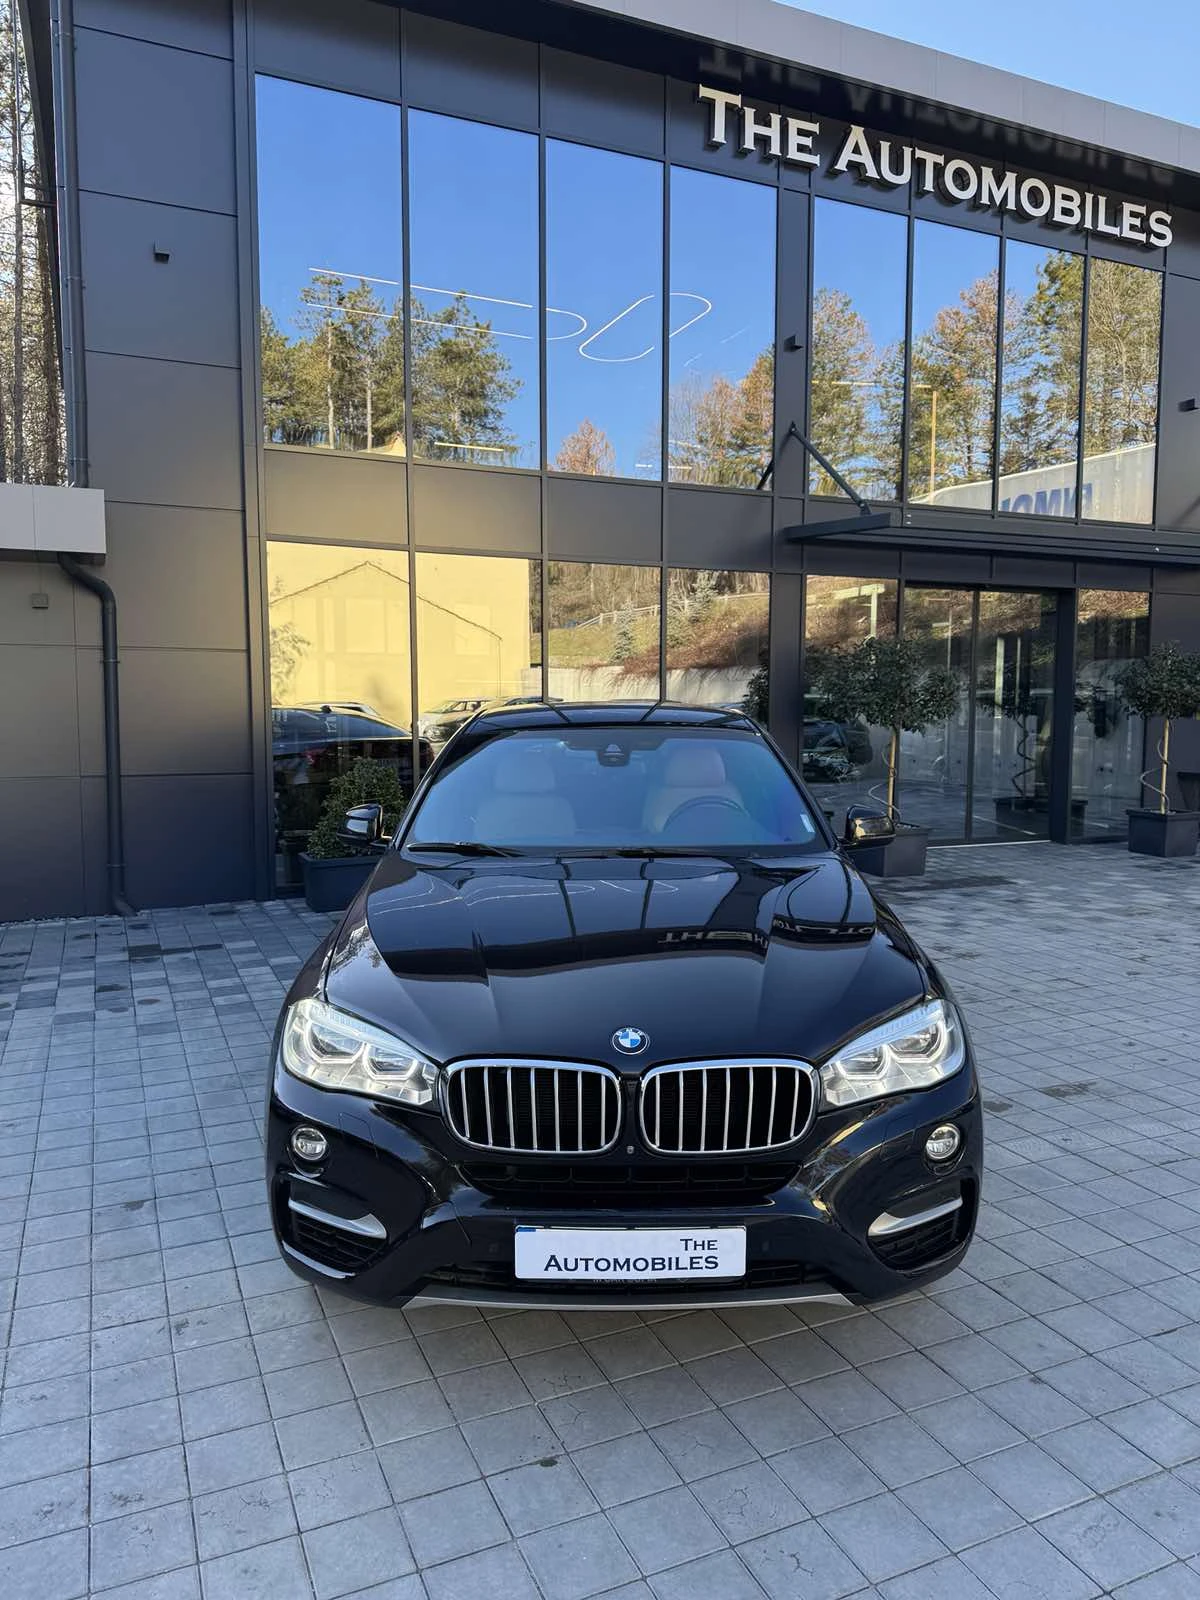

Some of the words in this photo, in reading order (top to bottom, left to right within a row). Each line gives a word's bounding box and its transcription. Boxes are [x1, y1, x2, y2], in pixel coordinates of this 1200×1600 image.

[699, 83, 820, 167] THE
[833, 125, 1173, 248] AUTOMOBILES
[680, 1238, 718, 1251] THE
[544, 1254, 719, 1272] AUTOMOBILES
